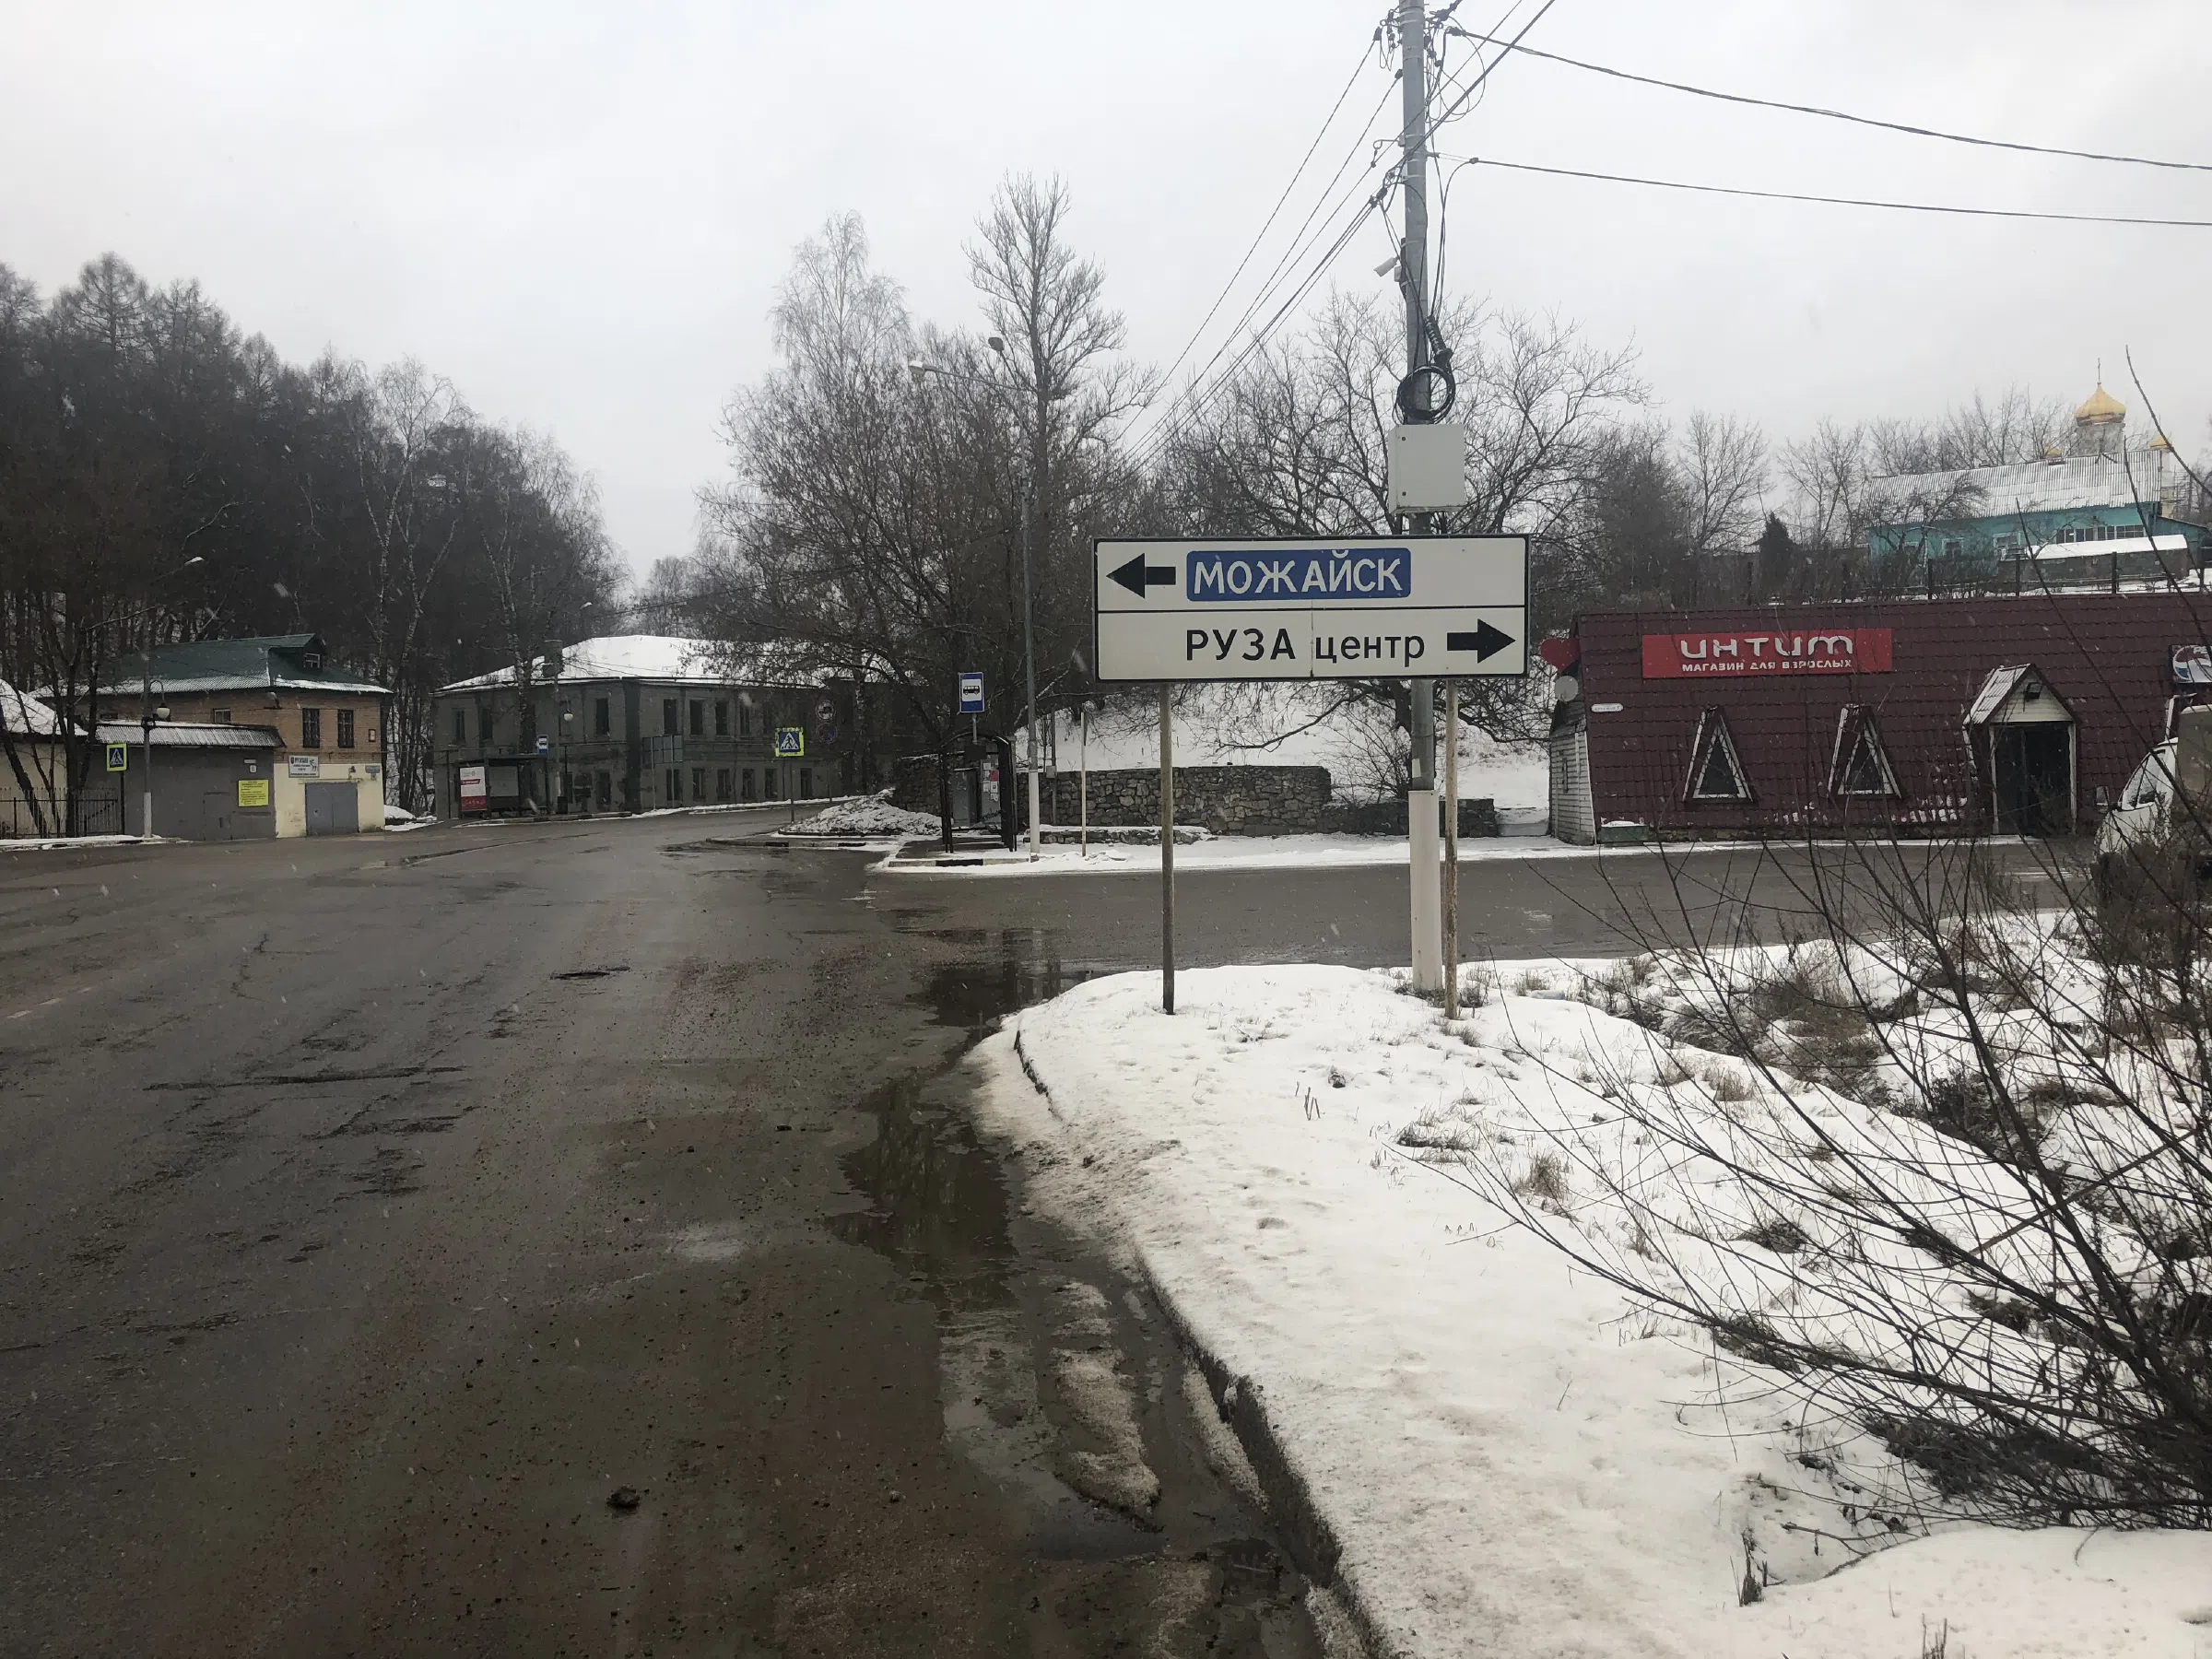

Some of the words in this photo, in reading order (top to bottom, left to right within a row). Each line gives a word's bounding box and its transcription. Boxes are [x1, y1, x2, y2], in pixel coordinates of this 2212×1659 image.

[1194, 549, 1403, 594] МОЖАЙСК
[1186, 629, 1296, 661] РУЗА
[1315, 633, 1425, 667] центр
[1682, 661, 1745, 672] МАГАЗИН
[1750, 661, 1776, 670] ДЛЯ
[1782, 659, 1853, 669] ВЗРОСЛЫХ
